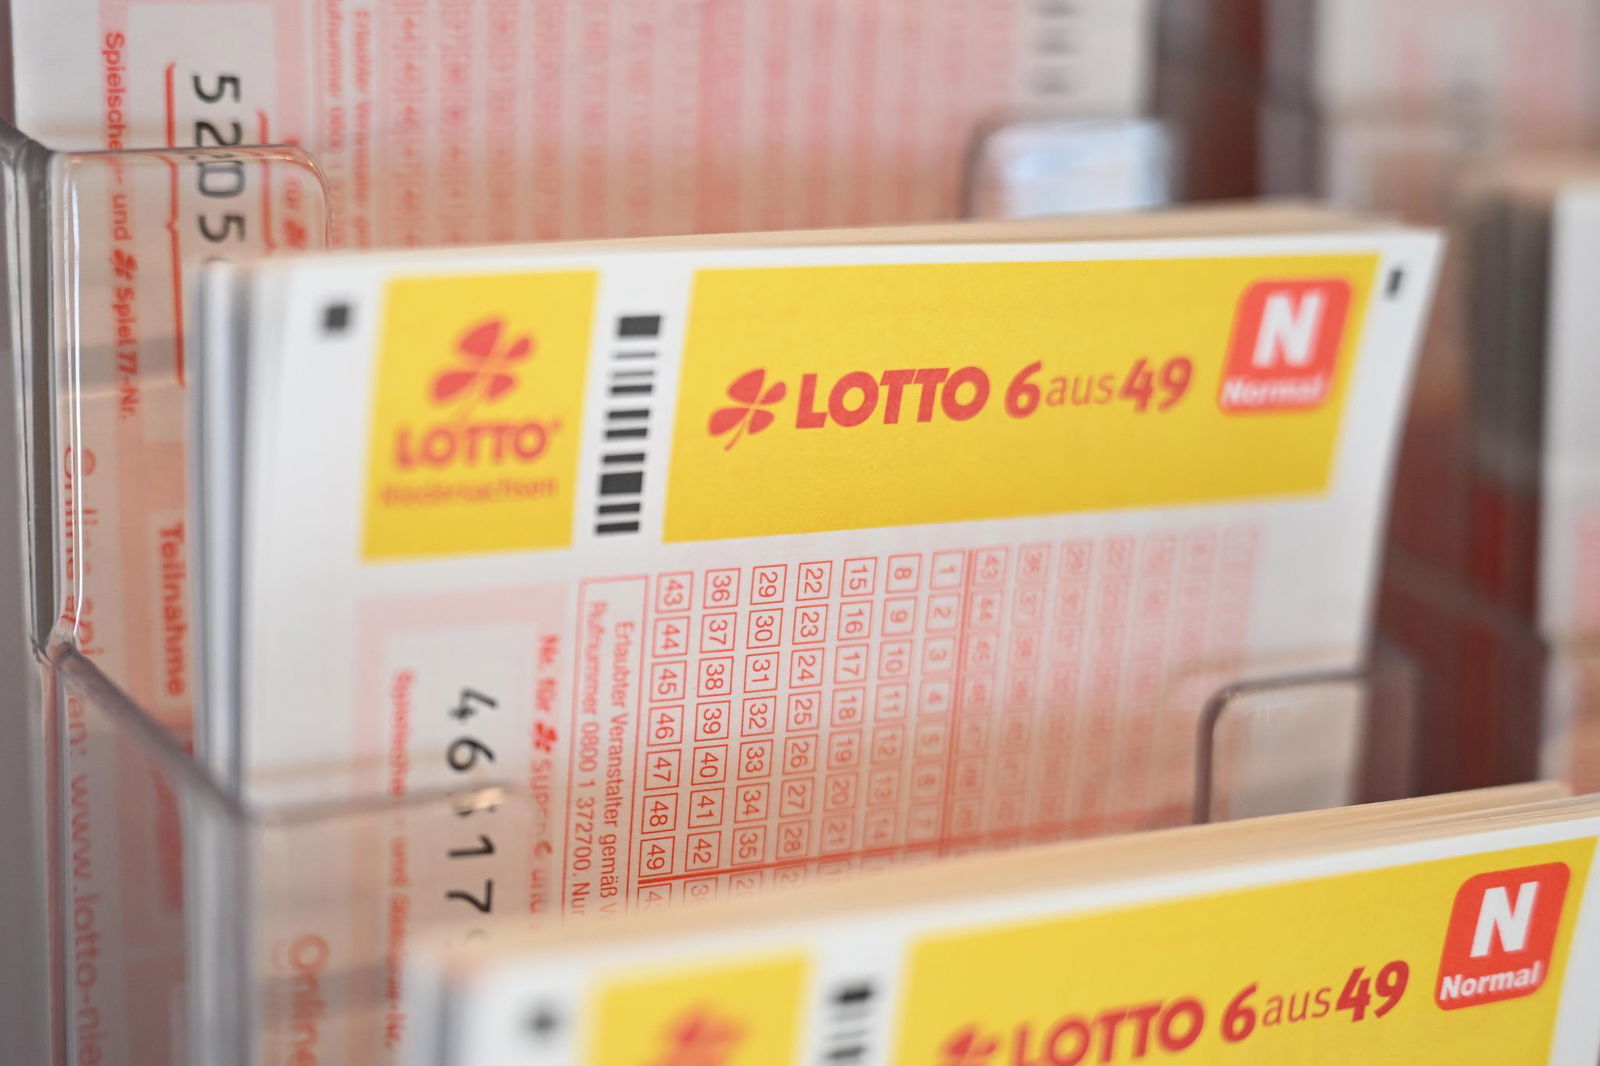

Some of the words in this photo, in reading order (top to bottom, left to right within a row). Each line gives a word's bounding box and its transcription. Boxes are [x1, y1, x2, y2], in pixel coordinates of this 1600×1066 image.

[112, 194, 131, 242] und
[113, 286, 138, 351] Spiel
[1251, 287, 1324, 369] N
[795, 366, 990, 429] LOTTO
[1220, 373, 1326, 408] Normal
[394, 421, 548, 471] LOTTO
[711, 575, 733, 602] 36
[758, 571, 779, 599] 29
[803, 567, 825, 595] 22
[848, 564, 870, 591] 15
[665, 579, 686, 606] 43
[161, 521, 188, 695] Teilnahme
[844, 607, 866, 635] 16
[661, 623, 682, 651] 44
[707, 618, 729, 646] 37
[754, 614, 775, 642] 30
[799, 610, 820, 638] 23
[613, 620, 634, 708] Erlaubter
[750, 658, 772, 685] 31
[795, 654, 817, 681] 24
[840, 650, 862, 678] 17
[884, 646, 905, 674] 10
[658, 667, 679, 695] 45
[704, 663, 725, 690] 38
[792, 697, 814, 725] 25
[837, 694, 859, 721] 18
[880, 689, 902, 713] 11
[654, 712, 676, 740] 46
[701, 707, 723, 735] 39
[747, 702, 769, 730] 32
[577, 720, 599, 773] 0800
[744, 746, 766, 774] 33
[789, 740, 810, 768] 26
[833, 736, 855, 764] 19
[604, 711, 629, 829] Veranstalter
[652, 755, 673, 783] 47
[698, 750, 720, 778] 40
[695, 793, 717, 821] 41
[742, 789, 763, 817] 34
[786, 783, 807, 811] 27
[649, 800, 670, 827] 48
[571, 796, 595, 877] 372700.
[738, 832, 760, 860] 35
[783, 825, 804, 853] 28
[646, 843, 667, 870] 49
[692, 837, 714, 865] 42
[597, 833, 618, 899] gemäß
[1468, 880, 1540, 959] N
[1438, 960, 1543, 1002] Normal
[1010, 995, 1205, 1066] LOTTO
